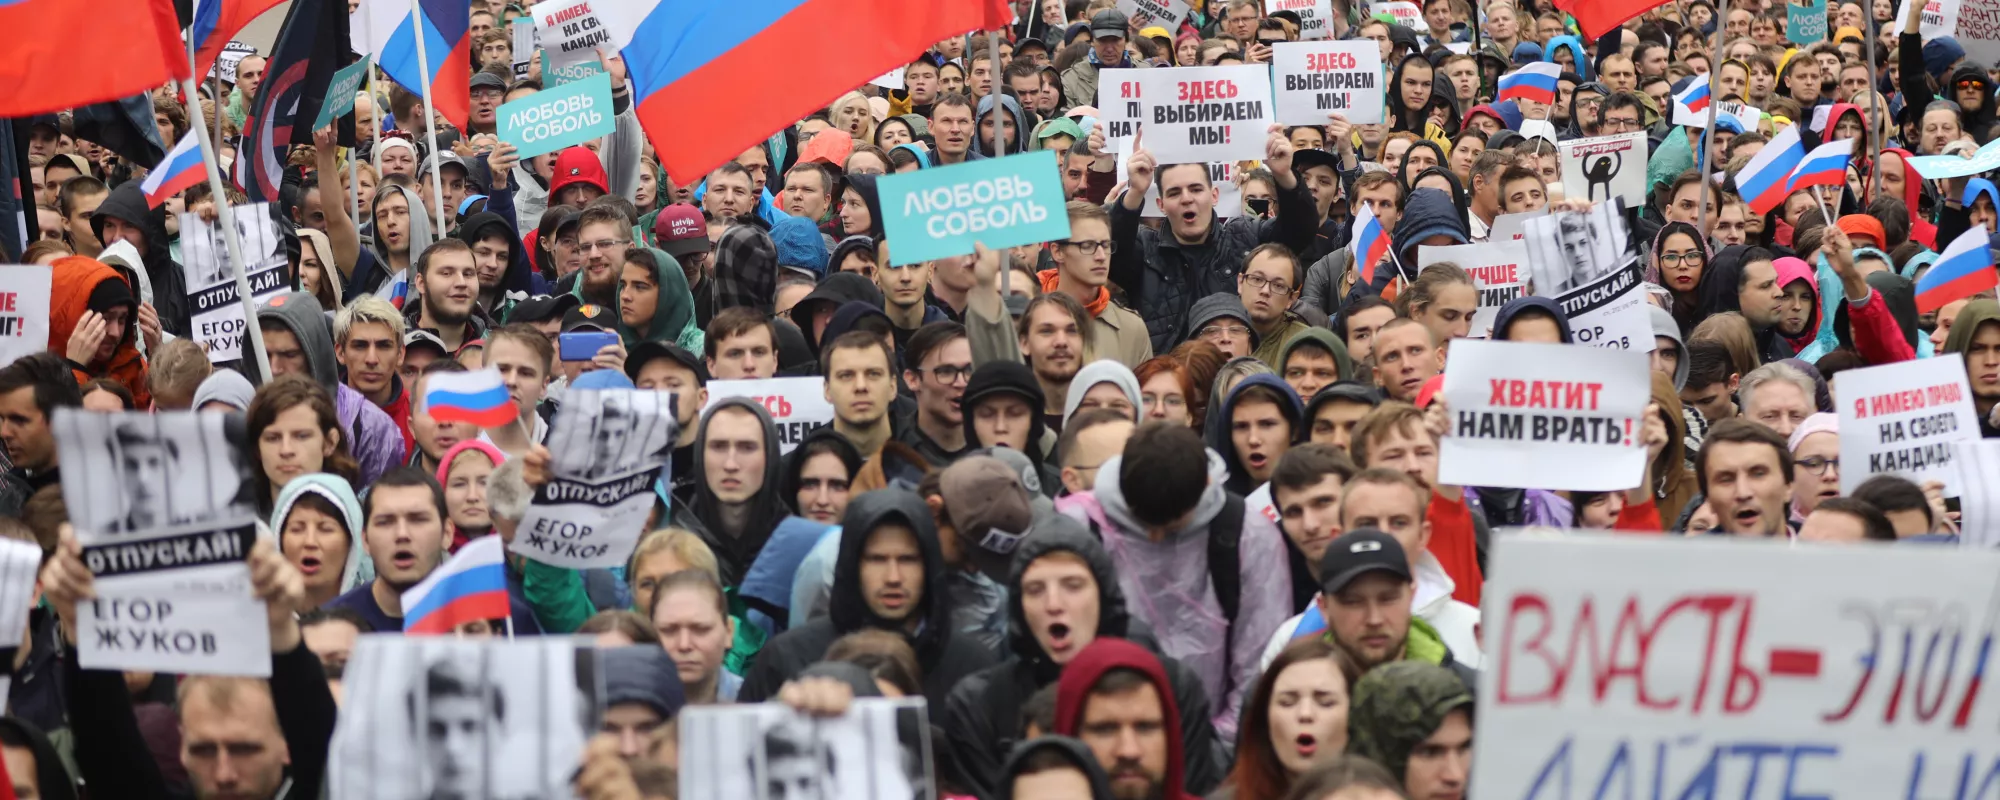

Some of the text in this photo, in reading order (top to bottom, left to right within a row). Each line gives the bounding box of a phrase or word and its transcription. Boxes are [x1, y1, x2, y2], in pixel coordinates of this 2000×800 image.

[545, 14, 555, 27] Я
[562, 24, 581, 37] НА
[1301, 19, 1327, 30] БОР!
[1921, 12, 1944, 26] ИНГ!
[561, 28, 611, 52] КАНДИД
[1306, 52, 1357, 72] ЗДЕСЬ
[1120, 81, 1132, 98] Я
[1177, 79, 1238, 104] ЗДЕСЬ
[1285, 72, 1374, 91] ВЫБИРАЕМ
[507, 93, 594, 131] ЛЮБОВЬ
[1153, 100, 1263, 124] ВЫБИРАЕМ
[1316, 92, 1351, 110] МЫ!
[521, 110, 602, 143] СОБОЛЬ
[1109, 121, 1132, 137] НА
[1189, 125, 1231, 145] МЫ!
[903, 174, 1034, 216] ЛЮБОВЬ
[671, 217, 695, 228] Latvija
[926, 199, 1048, 239] СОБОЛЬ
[1465, 263, 1518, 285] УЧШЕ
[1478, 285, 1526, 308] ТИНГ!
[1559, 272, 1635, 315] ТПУСКАЙ!
[201, 318, 245, 337] ЕГОР
[203, 335, 243, 351] ЖУК
[1489, 378, 1603, 410] ХВАТИТ
[1854, 382, 1963, 419] Я ИМЕЮ ПРАВО
[1458, 410, 1633, 447] НАМ ВРАТЬ!
[1878, 411, 1959, 444] НА СВОЕГО
[546, 474, 651, 504] ОТПУСКАЙ!
[534, 517, 593, 541] ЕГОР
[86, 530, 243, 574] ОТПУСКАЙ!
[524, 532, 611, 559] ЖУКОВ
[93, 598, 173, 623] ЕГОР
[95, 626, 218, 655] ЖУКОВ
